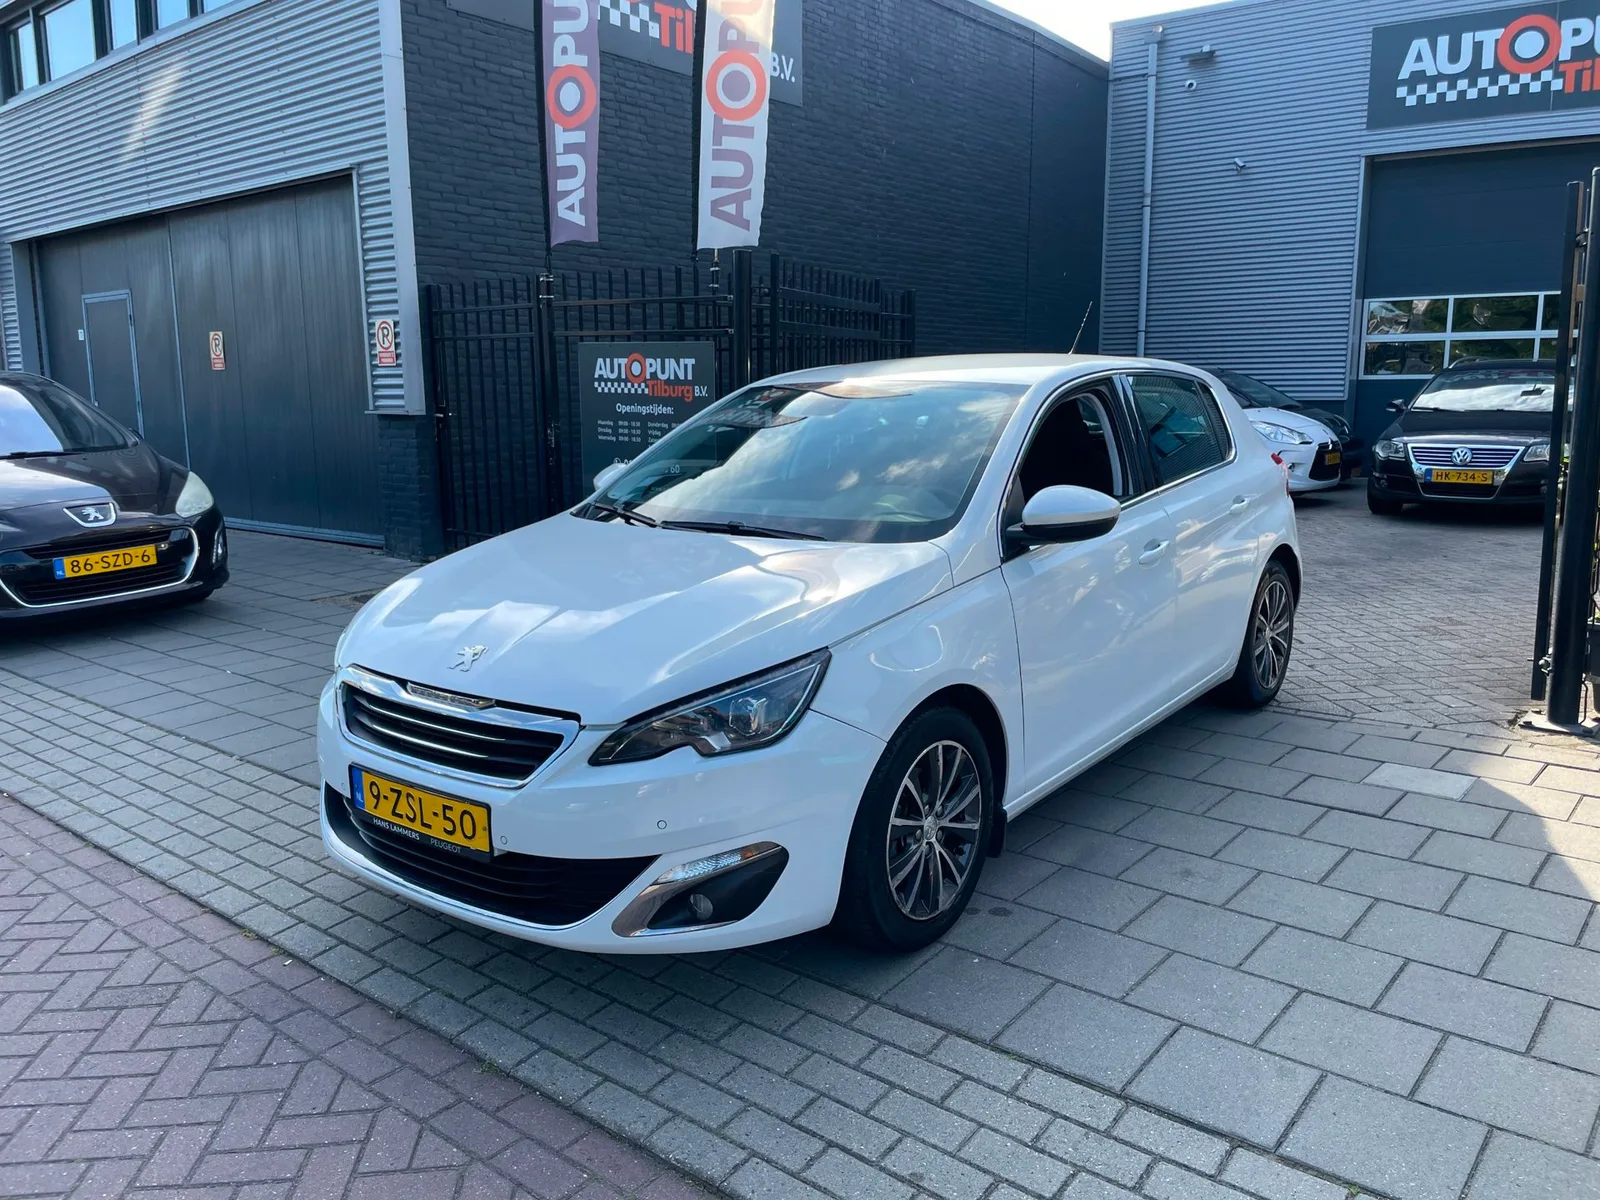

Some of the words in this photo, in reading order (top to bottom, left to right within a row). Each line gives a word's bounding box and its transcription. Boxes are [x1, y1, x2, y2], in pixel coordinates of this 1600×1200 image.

[1397, 14, 1600, 80] AUTOP
[594, 353, 695, 384] AUTOPUNT
[646, 380, 693, 403] Tilburg
[694, 386, 708, 397] B.V.
[615, 402, 675, 416] Openingstijden:
[1435, 471, 1488, 483] HK-734-S
[70, 549, 151, 574] 86-SZD-6
[369, 780, 477, 841] 9-ZSL-50
[373, 817, 390, 830] HANS
[390, 824, 420, 840] LAMMERS
[430, 837, 462, 854] PEUGEOT
